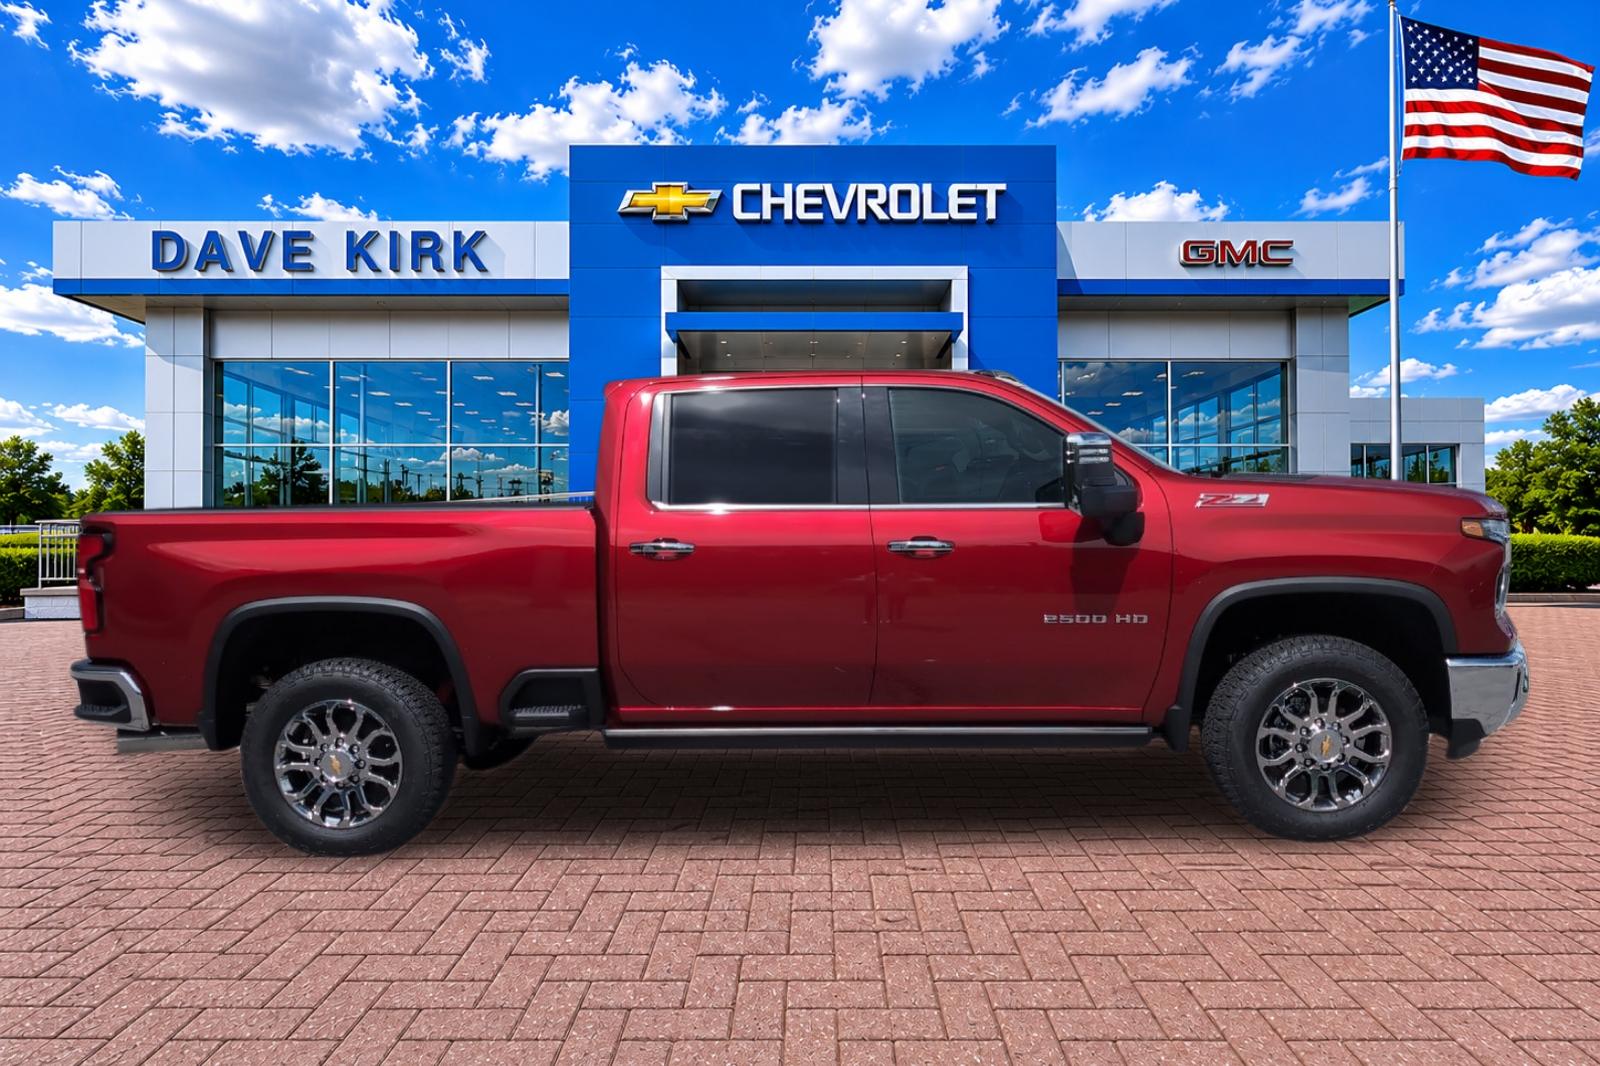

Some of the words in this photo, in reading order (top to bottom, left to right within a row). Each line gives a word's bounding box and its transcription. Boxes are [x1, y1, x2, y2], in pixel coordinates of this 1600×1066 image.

[732, 183, 1008, 222] CHEVROLET
[151, 230, 314, 273] DAVE
[345, 230, 488, 273] KIRK
[1180, 239, 1295, 267] GMC
[1043, 613, 1107, 624] 2500
[1115, 613, 1149, 624] HD
